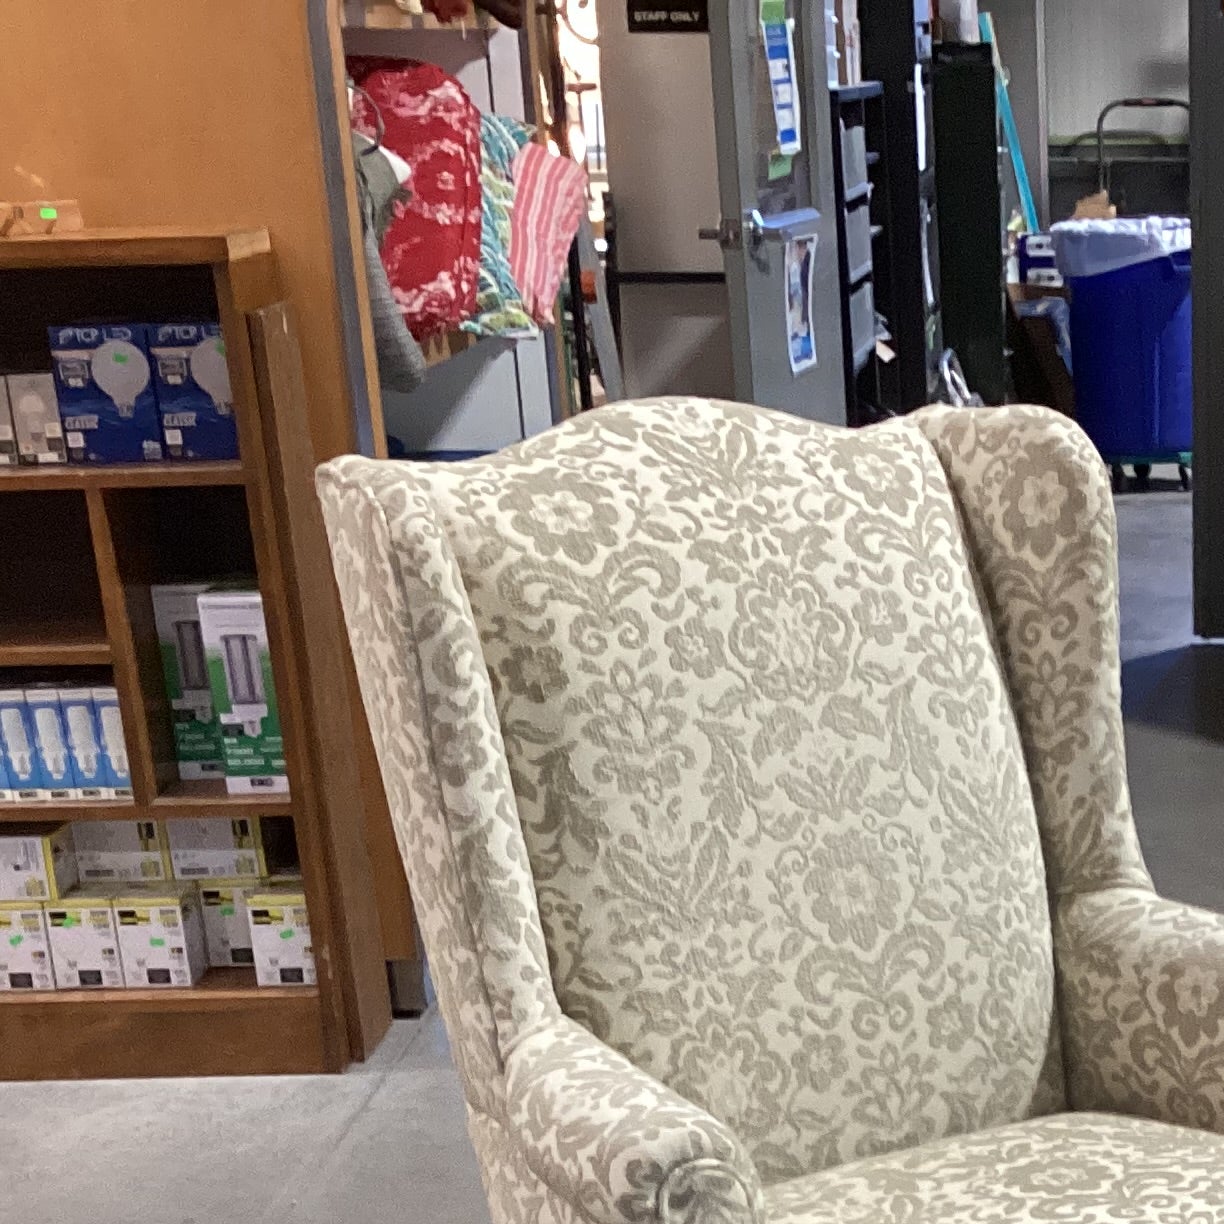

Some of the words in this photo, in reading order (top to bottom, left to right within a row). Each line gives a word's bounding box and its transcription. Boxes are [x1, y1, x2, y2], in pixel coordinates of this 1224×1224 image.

[634, 10, 667, 22] STAFF
[669, 10, 700, 23] ONLY
[76, 327, 99, 342] TCP
[175, 325, 197, 340] TCP
